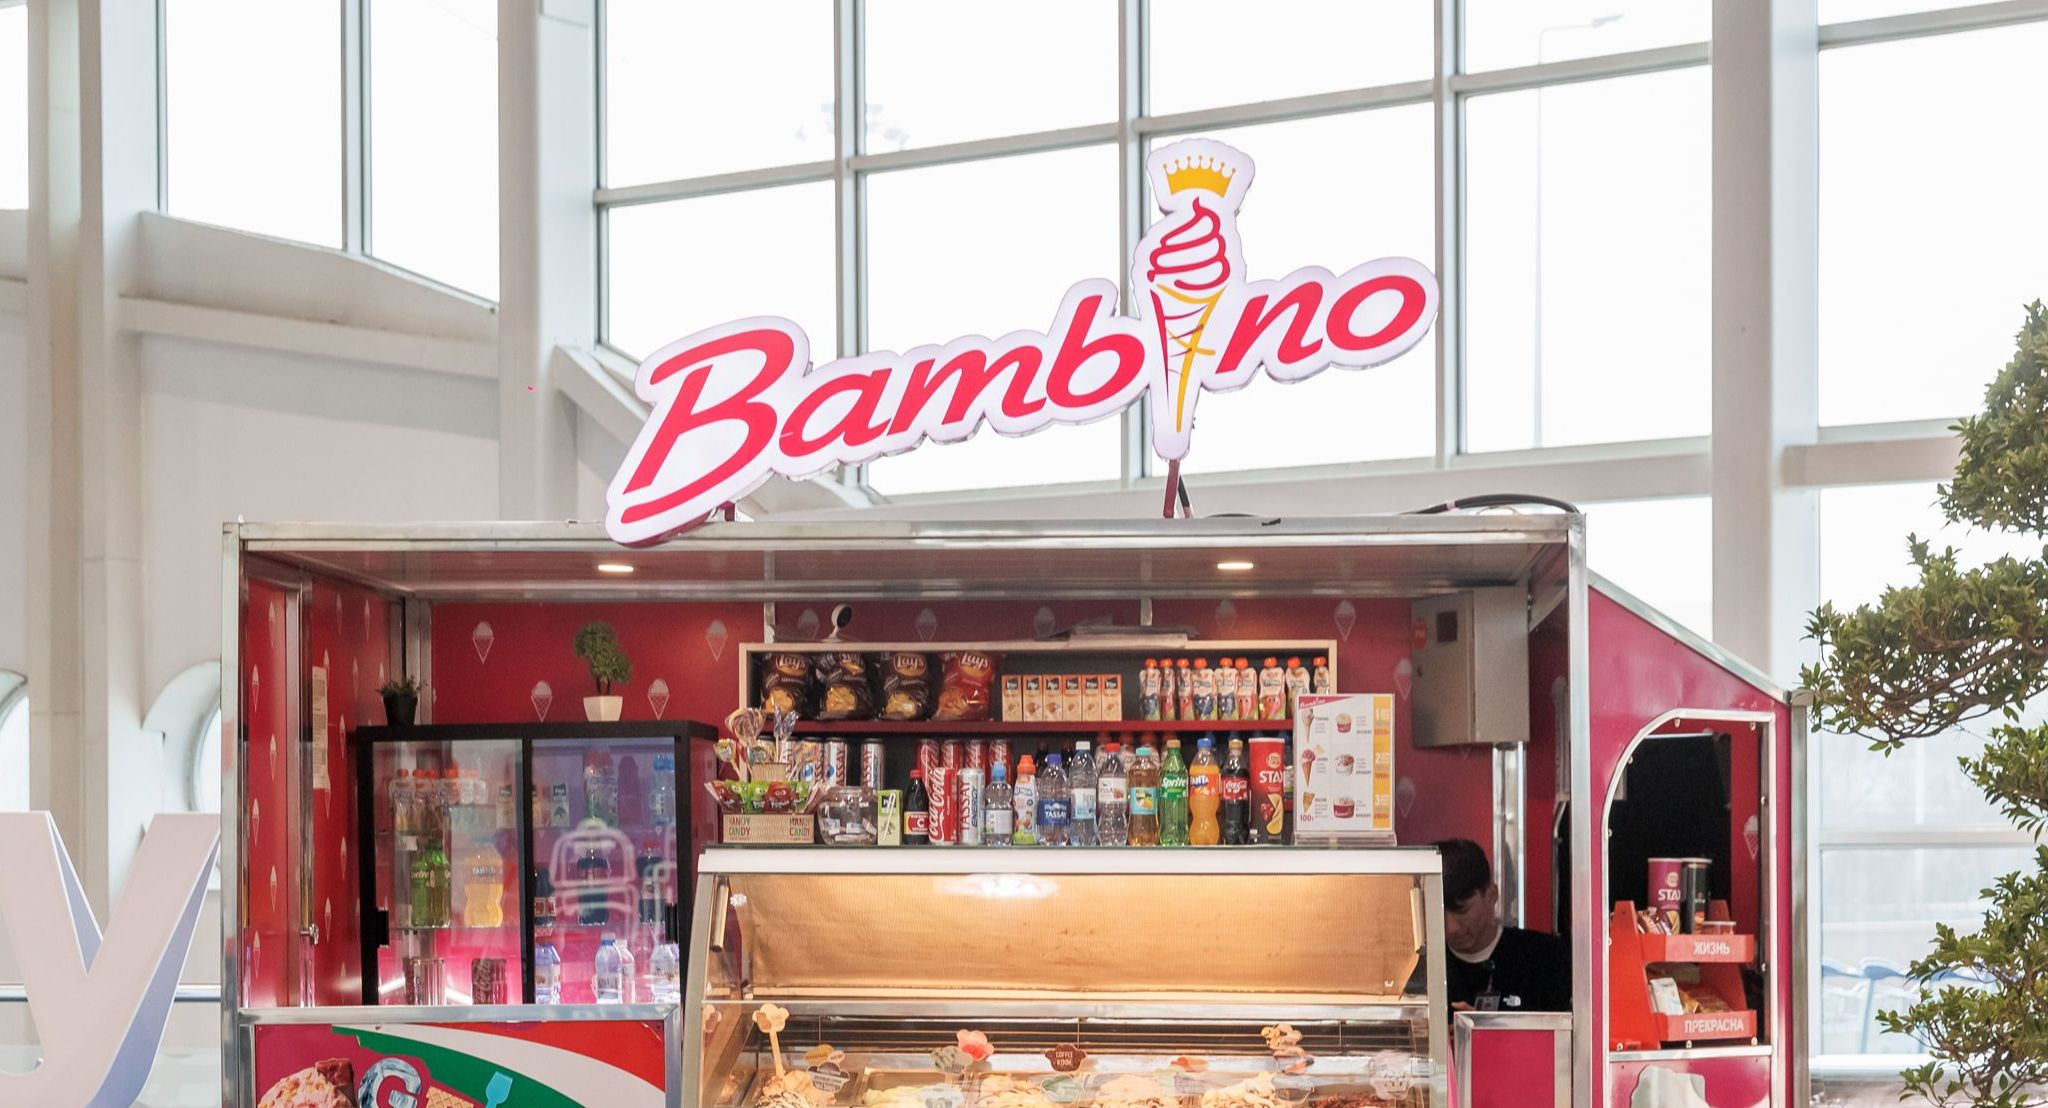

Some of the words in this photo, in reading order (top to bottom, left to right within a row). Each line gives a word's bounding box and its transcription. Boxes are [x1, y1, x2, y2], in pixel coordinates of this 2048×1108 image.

[622, 196, 1428, 524] Bambino
[1161, 776, 1188, 788] Sprite
[960, 781, 970, 831] TASSAY
[1694, 941, 1730, 955] ЖИЗНЬ
[1685, 1019, 1745, 1033] ПРЕКРАСНА
